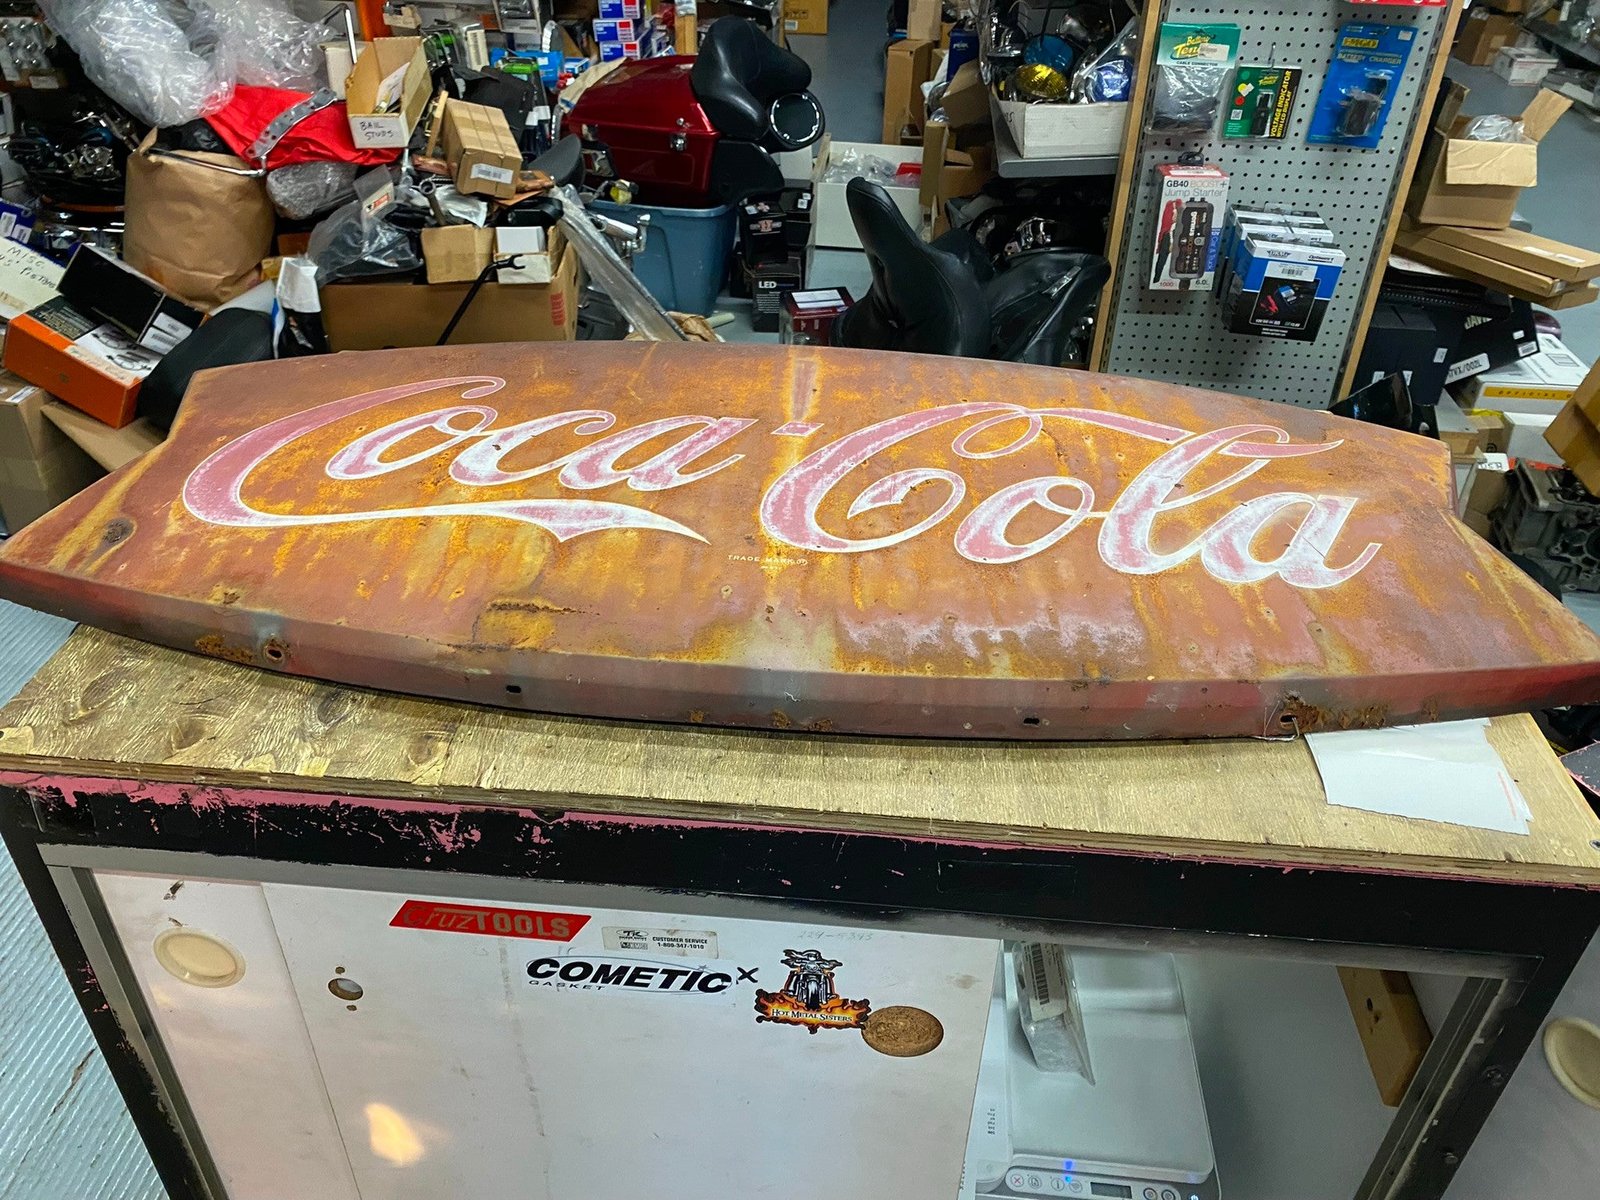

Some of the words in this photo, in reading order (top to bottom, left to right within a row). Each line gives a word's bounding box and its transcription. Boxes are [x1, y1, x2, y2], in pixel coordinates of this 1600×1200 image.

[1270, 107, 1283, 137] VOLTAGE
[1277, 70, 1292, 108] INDICATOR
[1166, 180, 1189, 188] GB40
[1192, 188, 1223, 197] Starter
[759, 281, 777, 289] LED
[728, 554, 760, 562] TRADE
[527, 957, 732, 993] COMETIC
[528, 980, 606, 990] GASKET
